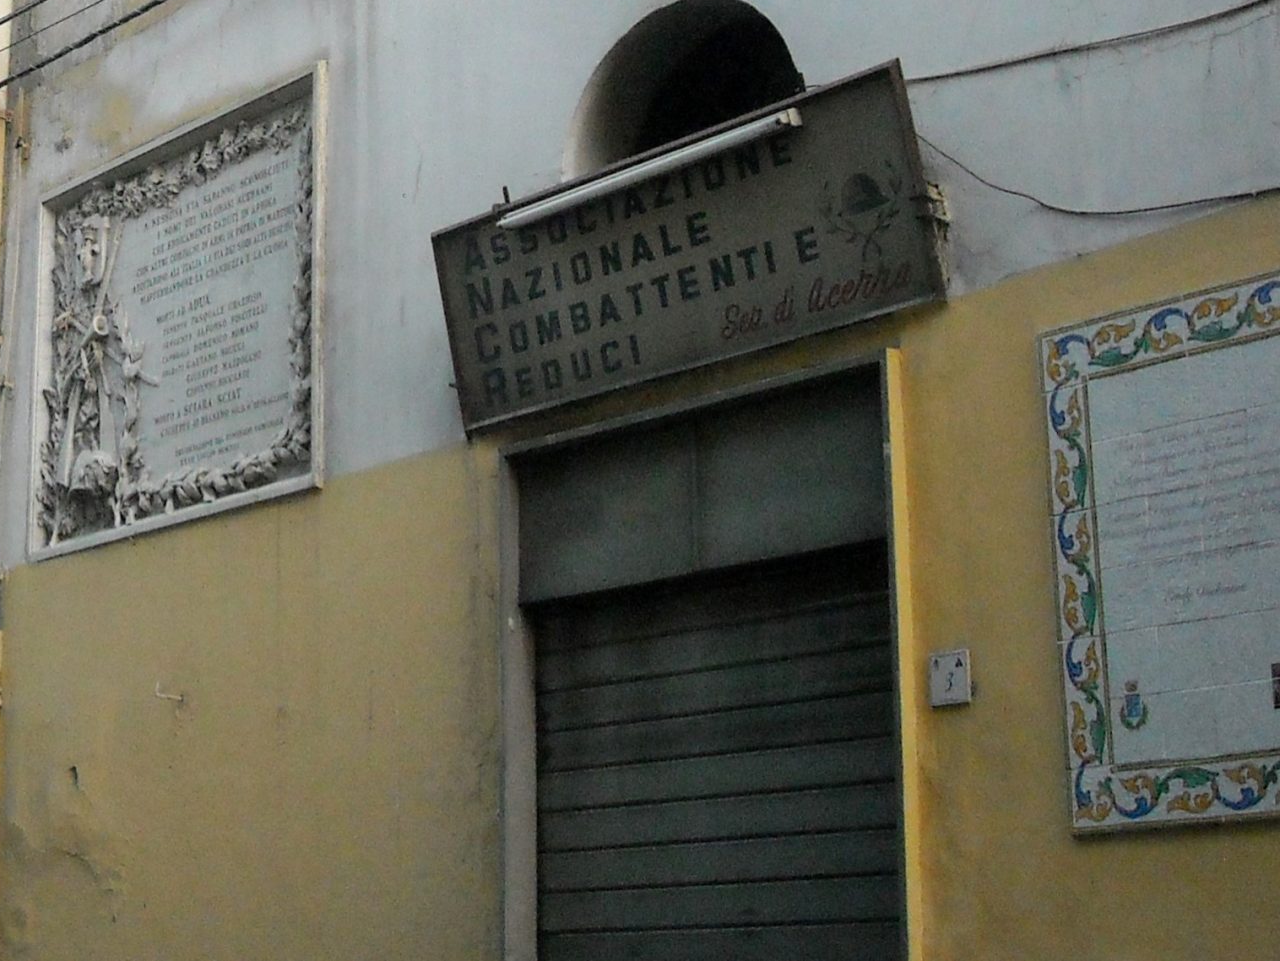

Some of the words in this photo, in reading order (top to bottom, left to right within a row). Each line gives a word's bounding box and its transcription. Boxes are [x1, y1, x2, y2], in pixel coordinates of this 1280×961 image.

[465, 140, 793, 275] ASSOCIAZIONE
[466, 210, 712, 320] NAZIONALE
[474, 240, 777, 365] COMBATTENTI
[792, 225, 820, 265] E
[483, 333, 642, 406] REDUCI
